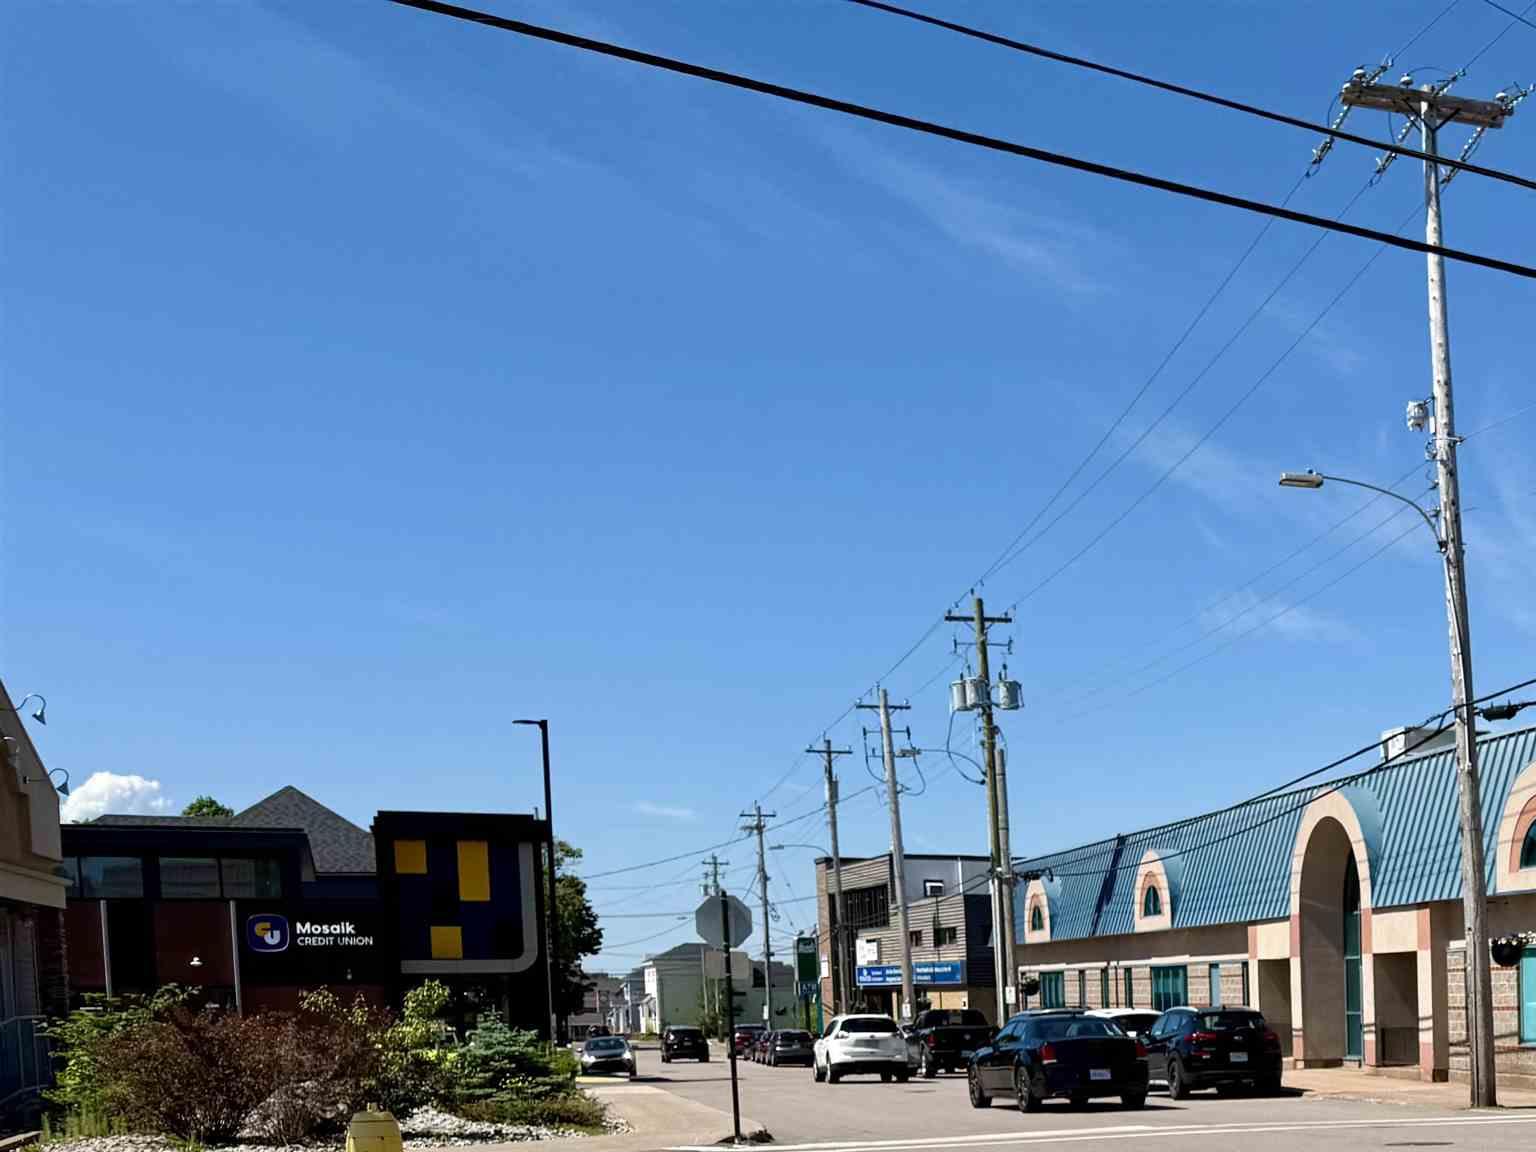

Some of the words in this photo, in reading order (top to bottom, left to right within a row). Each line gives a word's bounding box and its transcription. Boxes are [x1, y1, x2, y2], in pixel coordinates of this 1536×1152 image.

[296, 921, 356, 934] Mosaik
[297, 936, 335, 946] CREDIT
[337, 935, 373, 946] UNION
